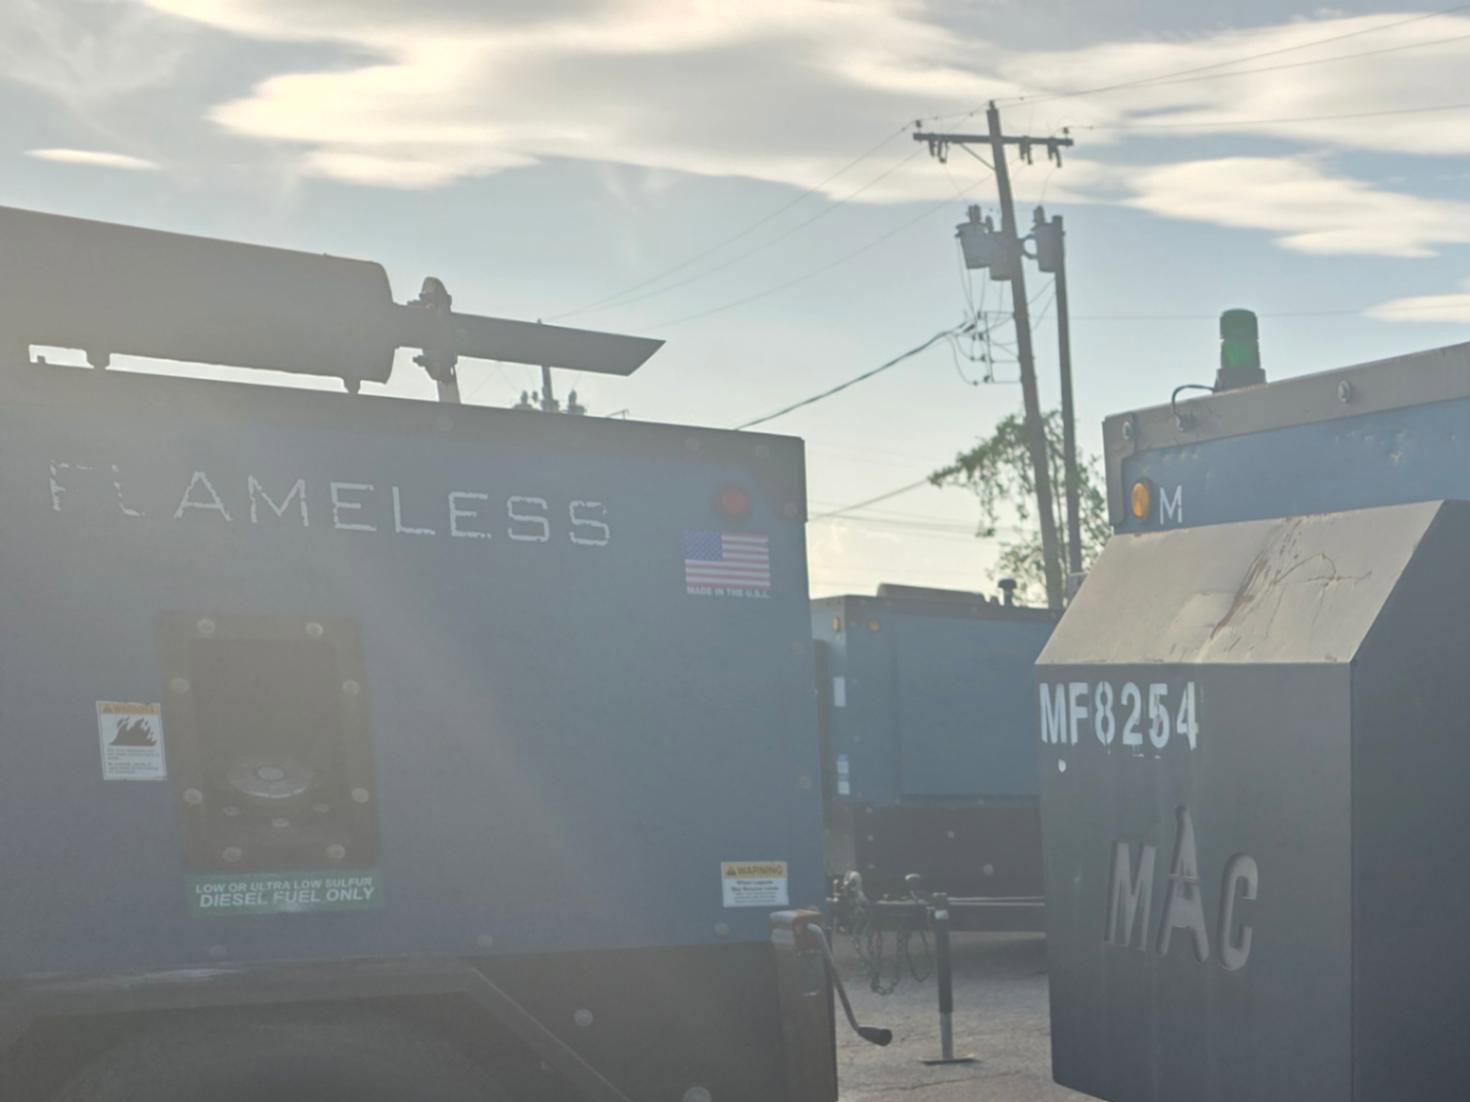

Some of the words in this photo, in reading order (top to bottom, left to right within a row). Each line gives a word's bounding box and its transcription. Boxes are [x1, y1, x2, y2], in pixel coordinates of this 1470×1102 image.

[50, 460, 610, 546] FLAMELESS
[1039, 681, 1199, 750] MF8254
[196, 884, 226, 894] LOW
[228, 882, 248, 893] OR
[250, 881, 290, 892] ULTRA
[293, 879, 322, 889] LOW
[325, 877, 373, 888] SULFUR
[200, 892, 267, 908] DIESEL
[273, 890, 321, 904] FUEL
[326, 887, 376, 901] ONLY
[1103, 805, 1259, 972] MAC
